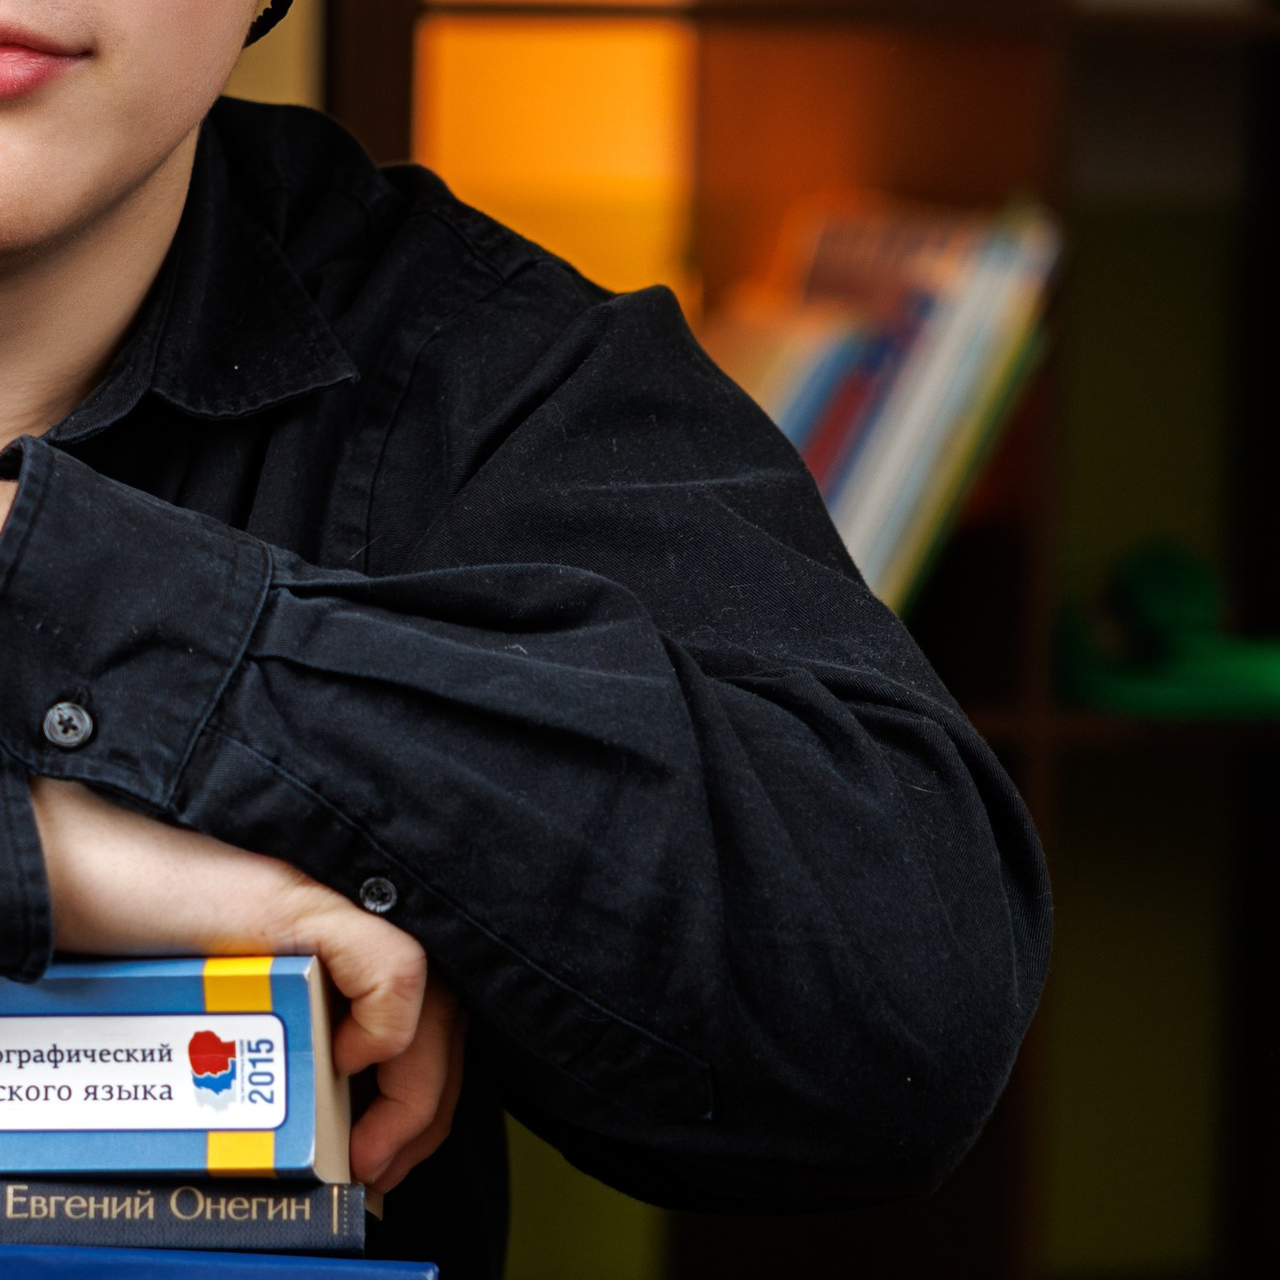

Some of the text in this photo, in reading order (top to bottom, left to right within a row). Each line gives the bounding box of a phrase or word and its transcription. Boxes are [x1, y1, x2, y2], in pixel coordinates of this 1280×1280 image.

[246, 1038, 275, 1105] 2015
[83, 1083, 174, 1102] языка
[5, 1184, 311, 1221] Евгений Онегин
